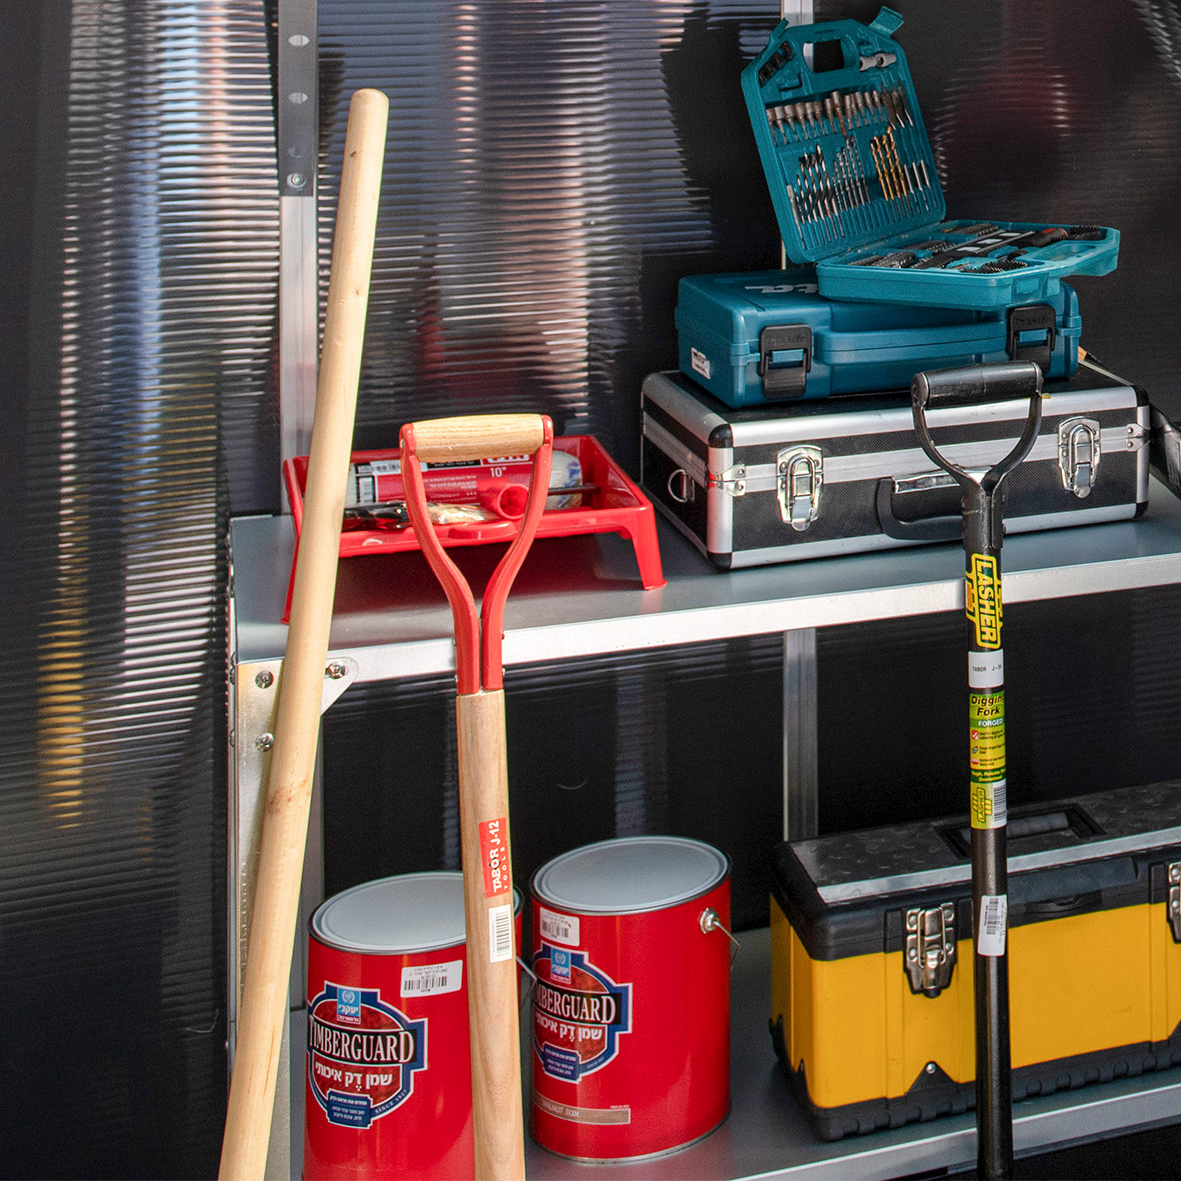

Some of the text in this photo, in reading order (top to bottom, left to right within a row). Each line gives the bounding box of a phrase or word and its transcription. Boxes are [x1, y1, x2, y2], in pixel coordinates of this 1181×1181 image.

[976, 560, 998, 643] LASHER
[977, 706, 1000, 717] Fork
[978, 718, 1003, 727] FORGED
[488, 820, 503, 893] TABOR J-12
[500, 846, 509, 890] TOOLS
[536, 984, 616, 1024] MBERGUARD
[309, 1014, 415, 1063] TIMBERGUARD
[578, 1026, 603, 1042] שמן
[315, 1061, 342, 1082] איכותי
[365, 1073, 393, 1090] שמן
